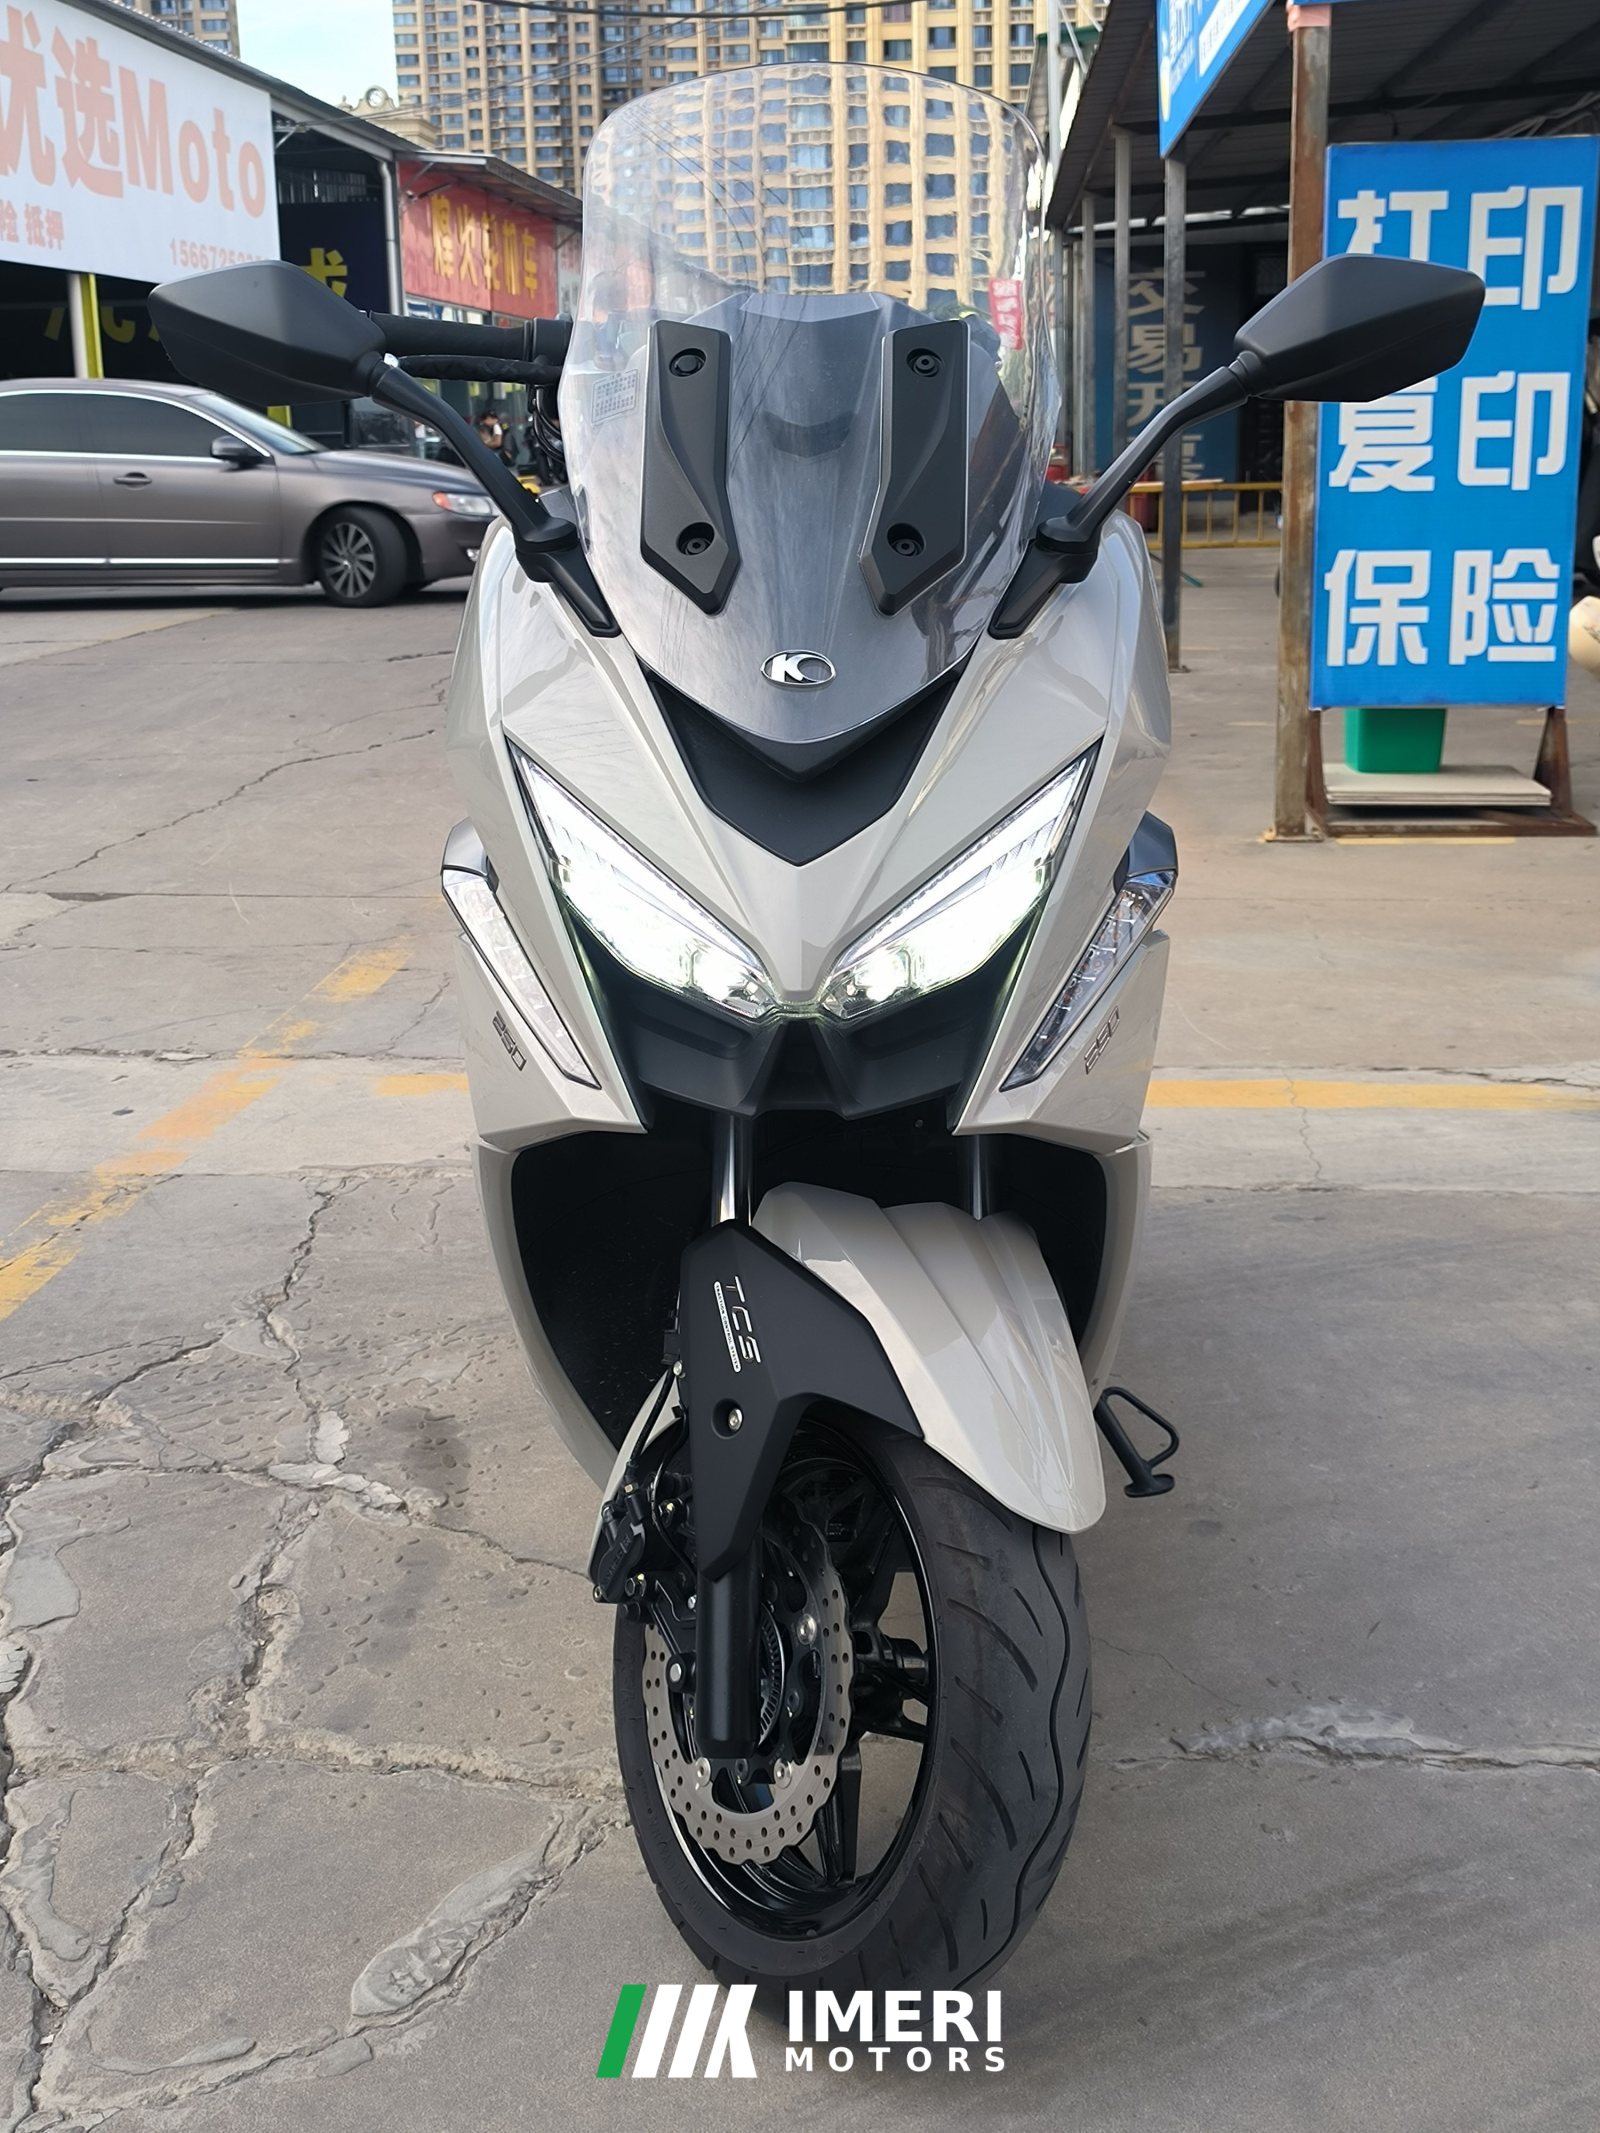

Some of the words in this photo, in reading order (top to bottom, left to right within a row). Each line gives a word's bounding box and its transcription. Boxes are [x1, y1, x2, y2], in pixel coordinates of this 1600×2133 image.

[1328, 370, 1571, 492] 复印
[1324, 548, 1560, 667] 保险
[492, 1010, 527, 1072] 250
[1084, 1006, 1120, 1075] 250
[726, 1275, 762, 1363] TCS
